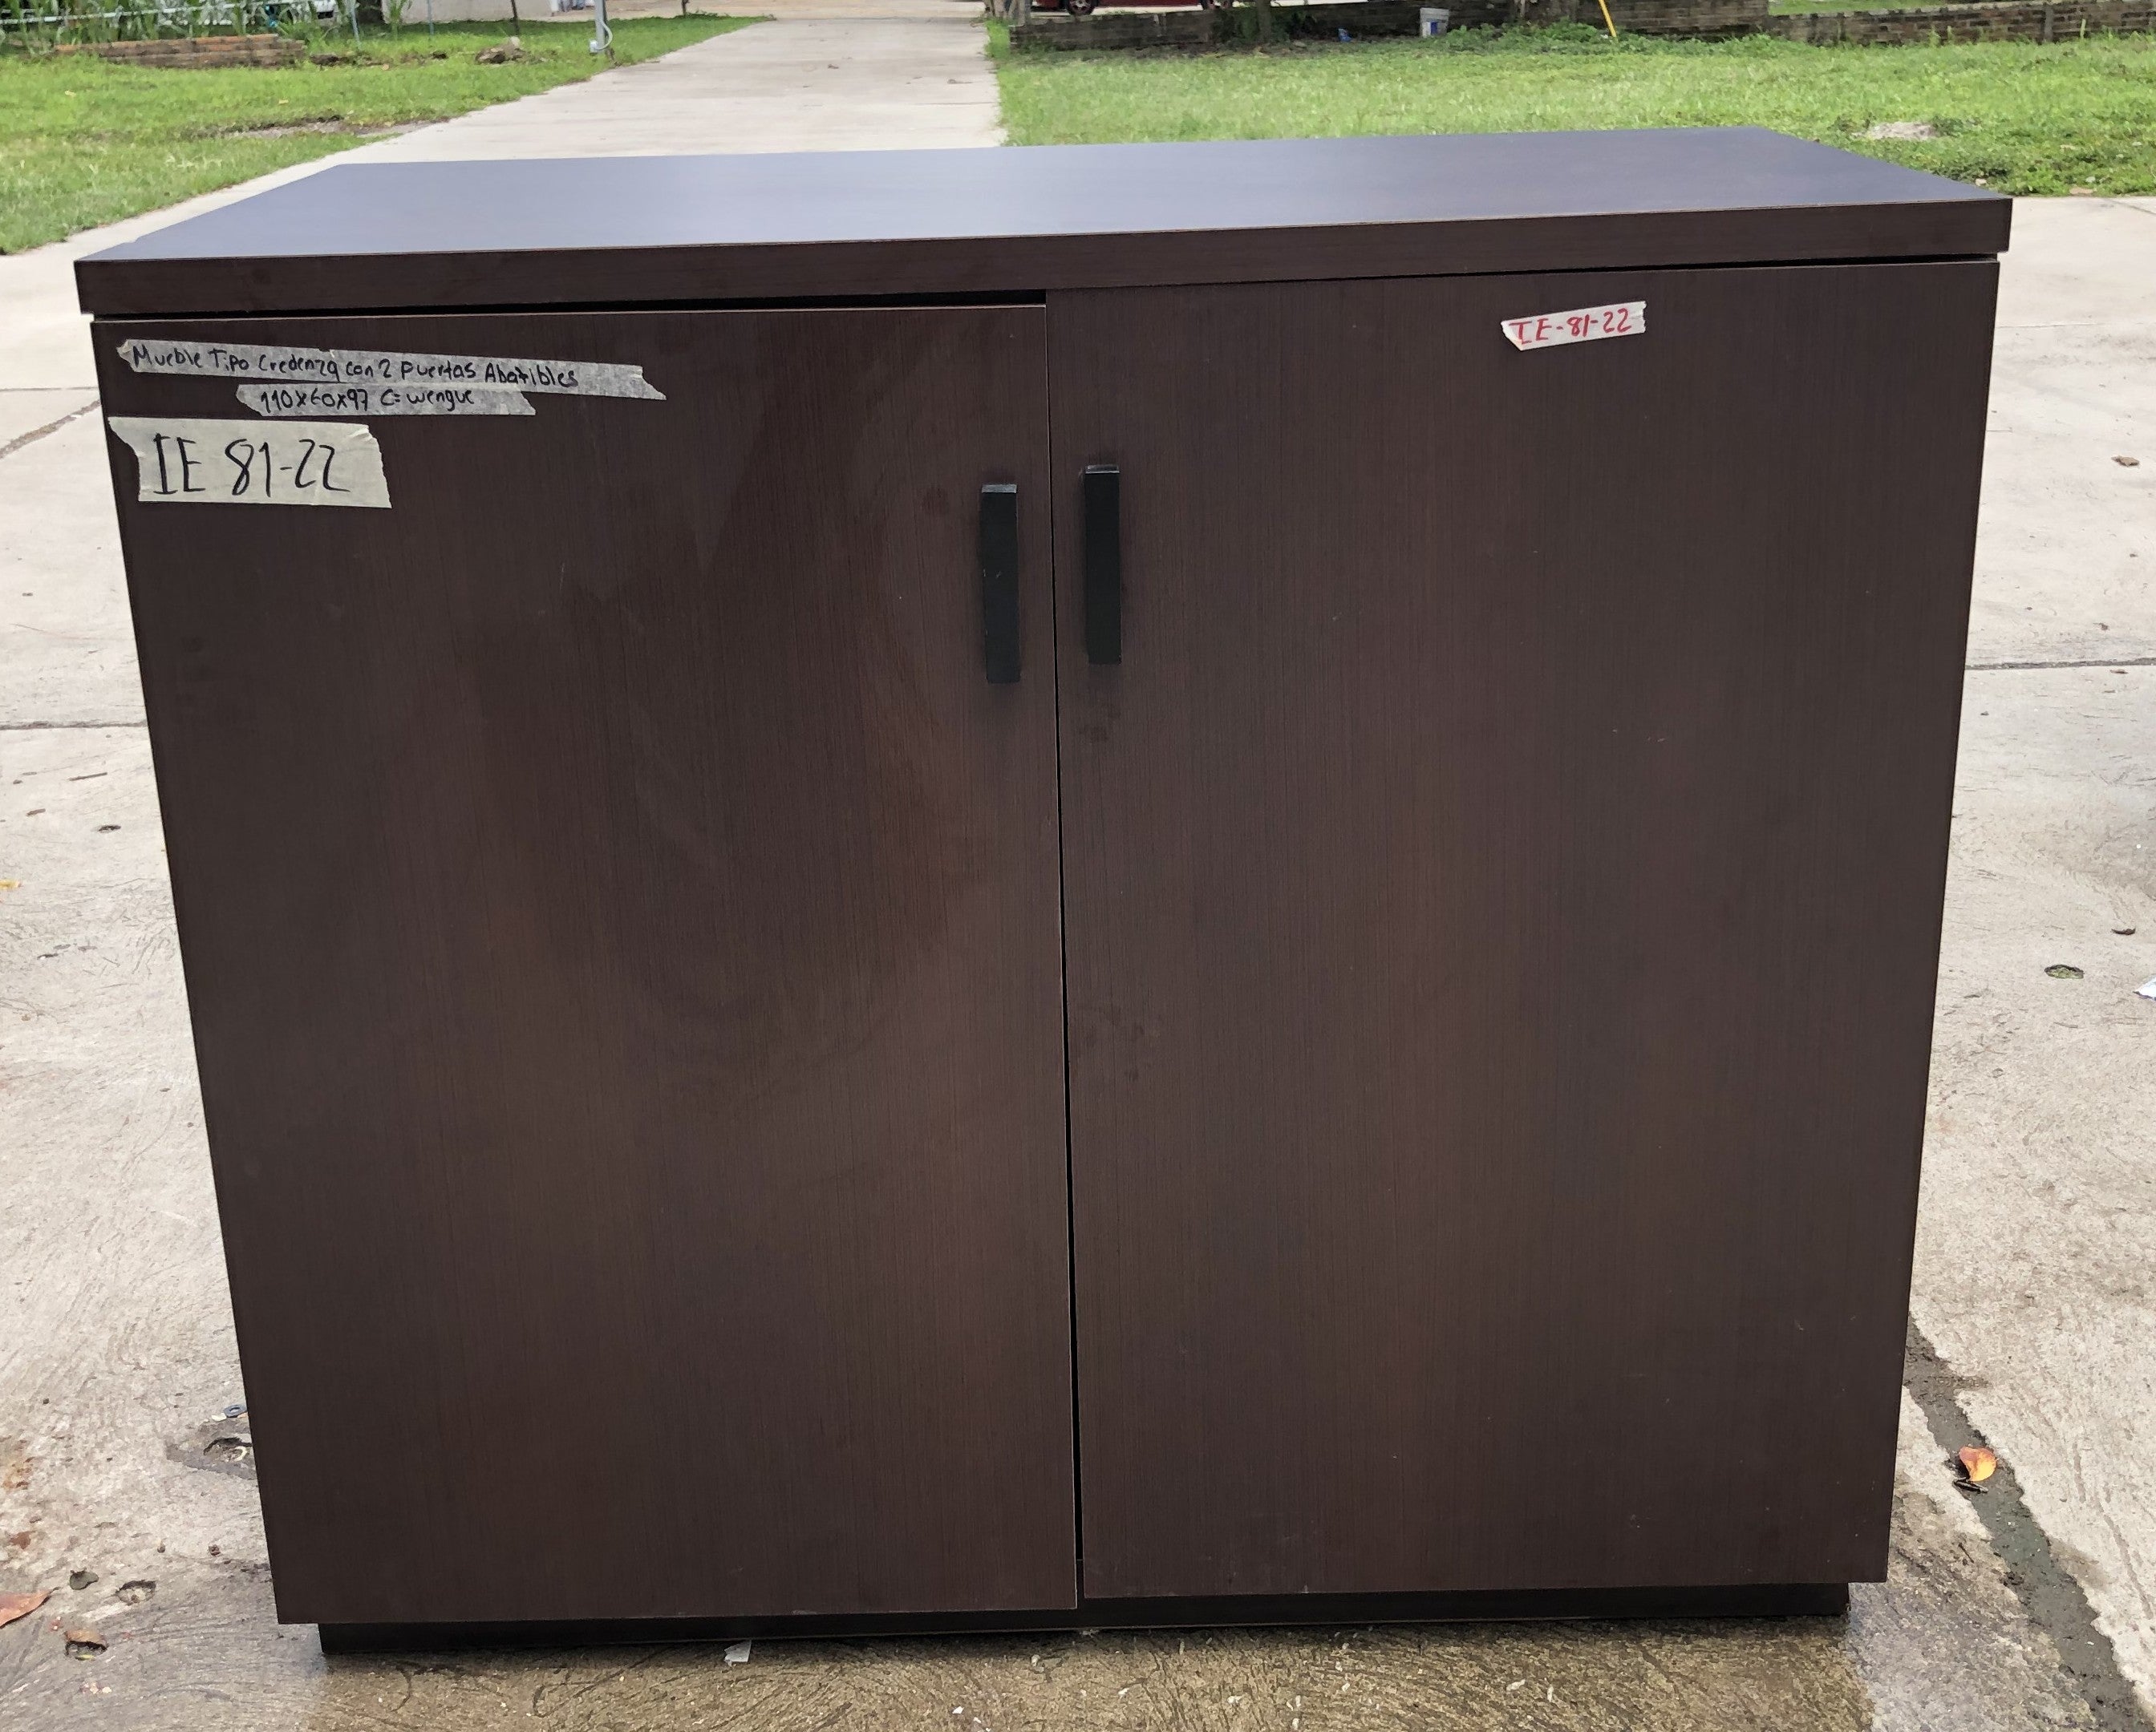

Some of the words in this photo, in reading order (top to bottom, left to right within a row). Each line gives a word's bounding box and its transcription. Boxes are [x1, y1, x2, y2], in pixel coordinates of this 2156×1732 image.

[132, 344, 201, 368] Mueble
[208, 348, 249, 373] Tipo
[378, 359, 392, 378] 2
[484, 362, 579, 388] Abatibles
[153, 433, 206, 495] IE
[225, 439, 351, 497] 81-22
